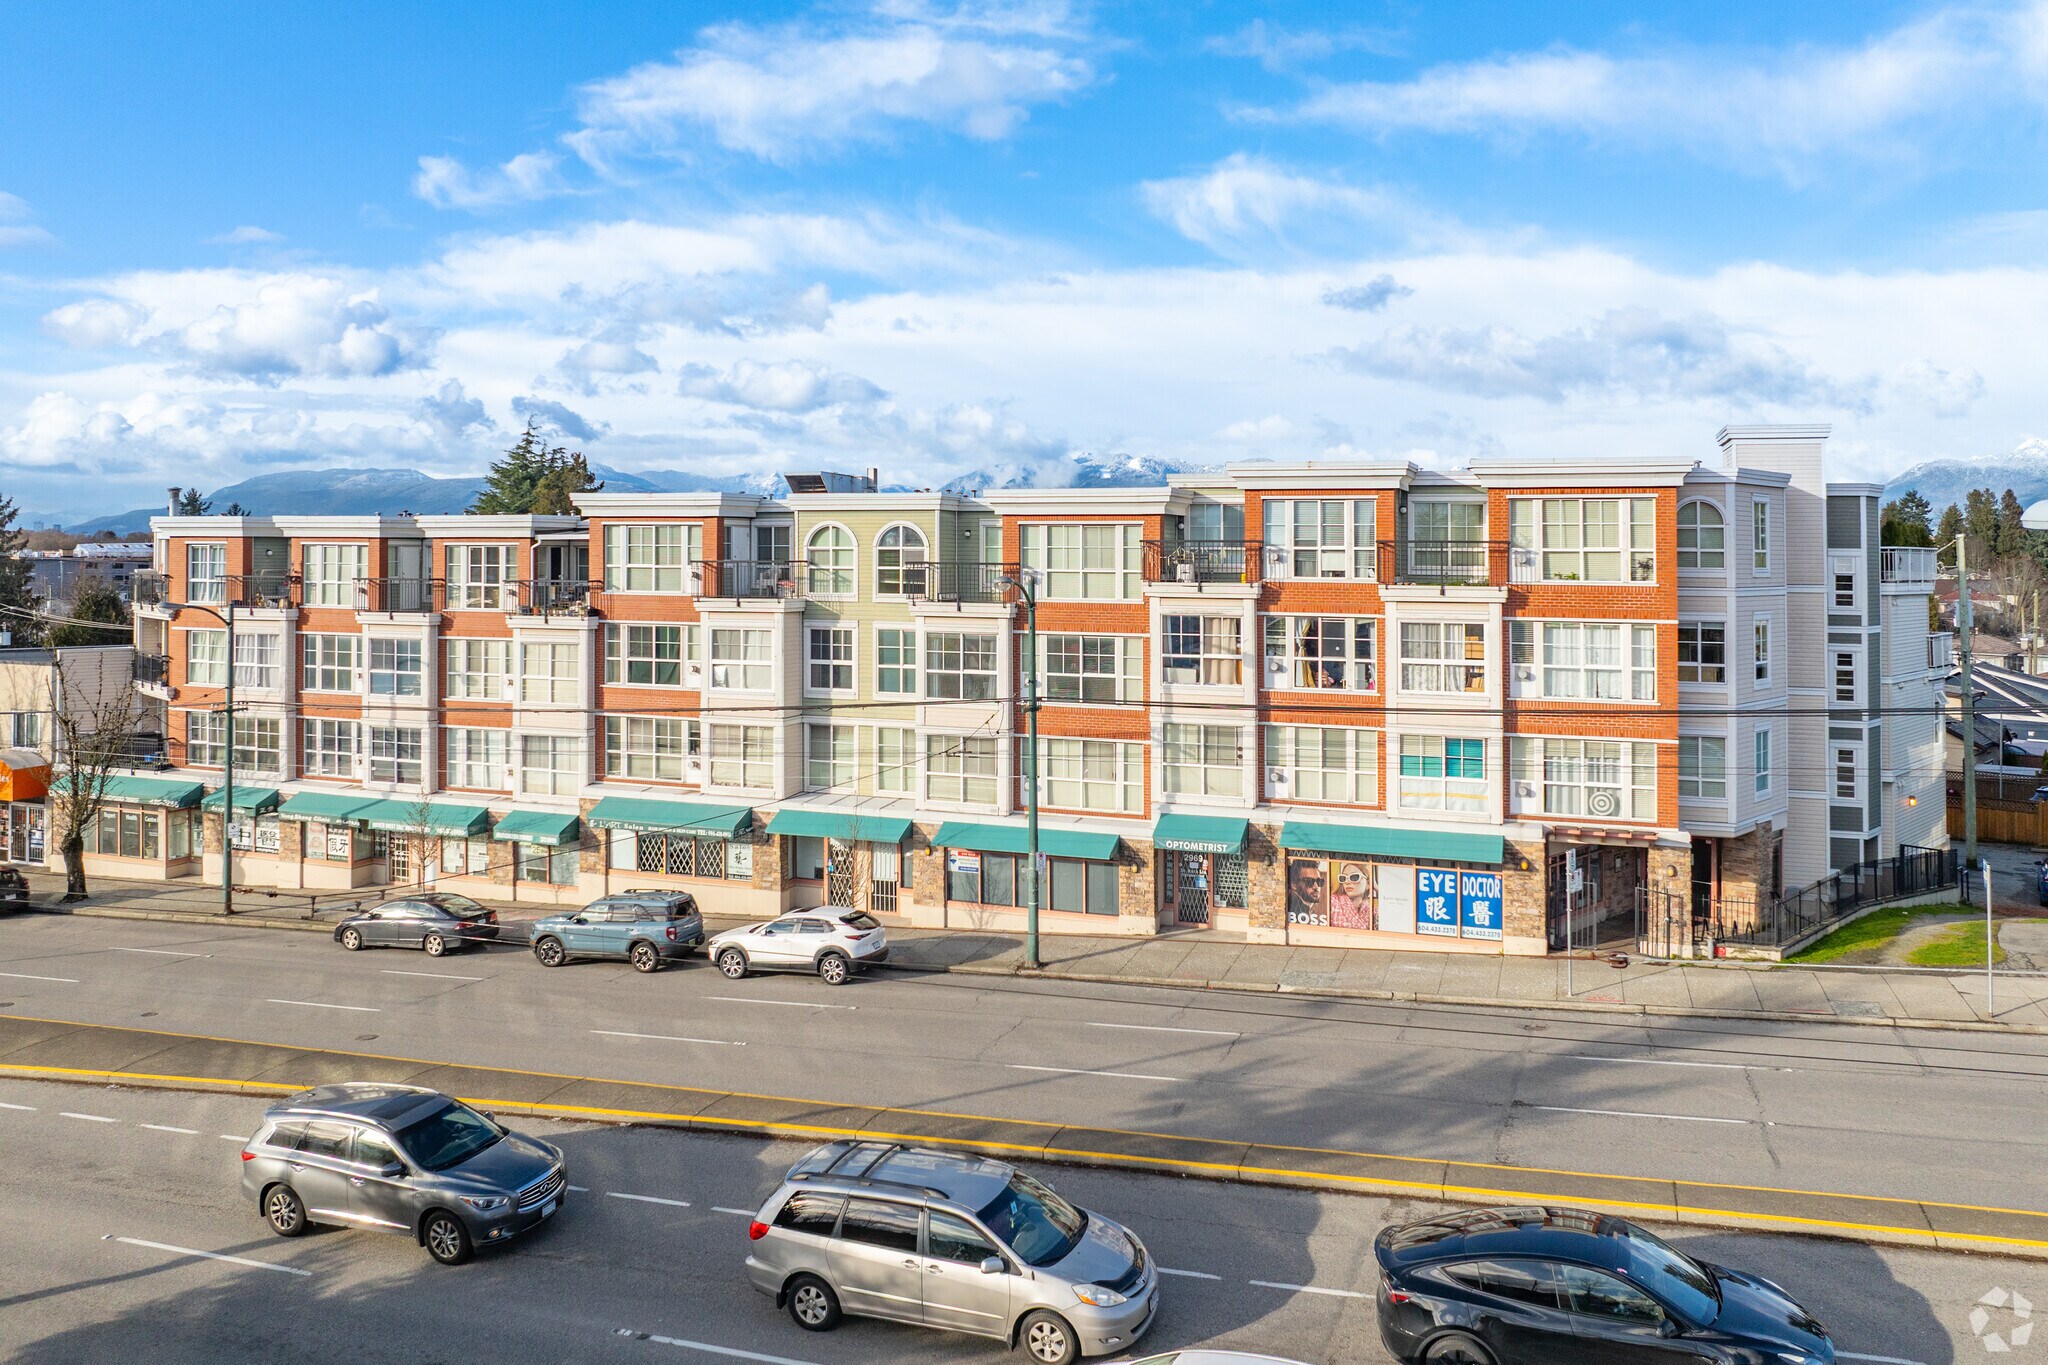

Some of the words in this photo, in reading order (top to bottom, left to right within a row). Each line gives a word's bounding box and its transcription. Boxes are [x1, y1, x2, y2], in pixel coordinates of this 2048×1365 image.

[313, 815, 331, 823] Clinic
[623, 823, 644, 831] Salon
[1165, 840, 1228, 852] OPTOMETRIST
[1184, 853, 1204, 862] 2969
[1418, 872, 1456, 894] EYE
[1462, 875, 1501, 899] DOCTOR
[1423, 895, 1451, 921] 眼
[1468, 900, 1494, 927] 醫
[1288, 911, 1328, 927] BOSS
